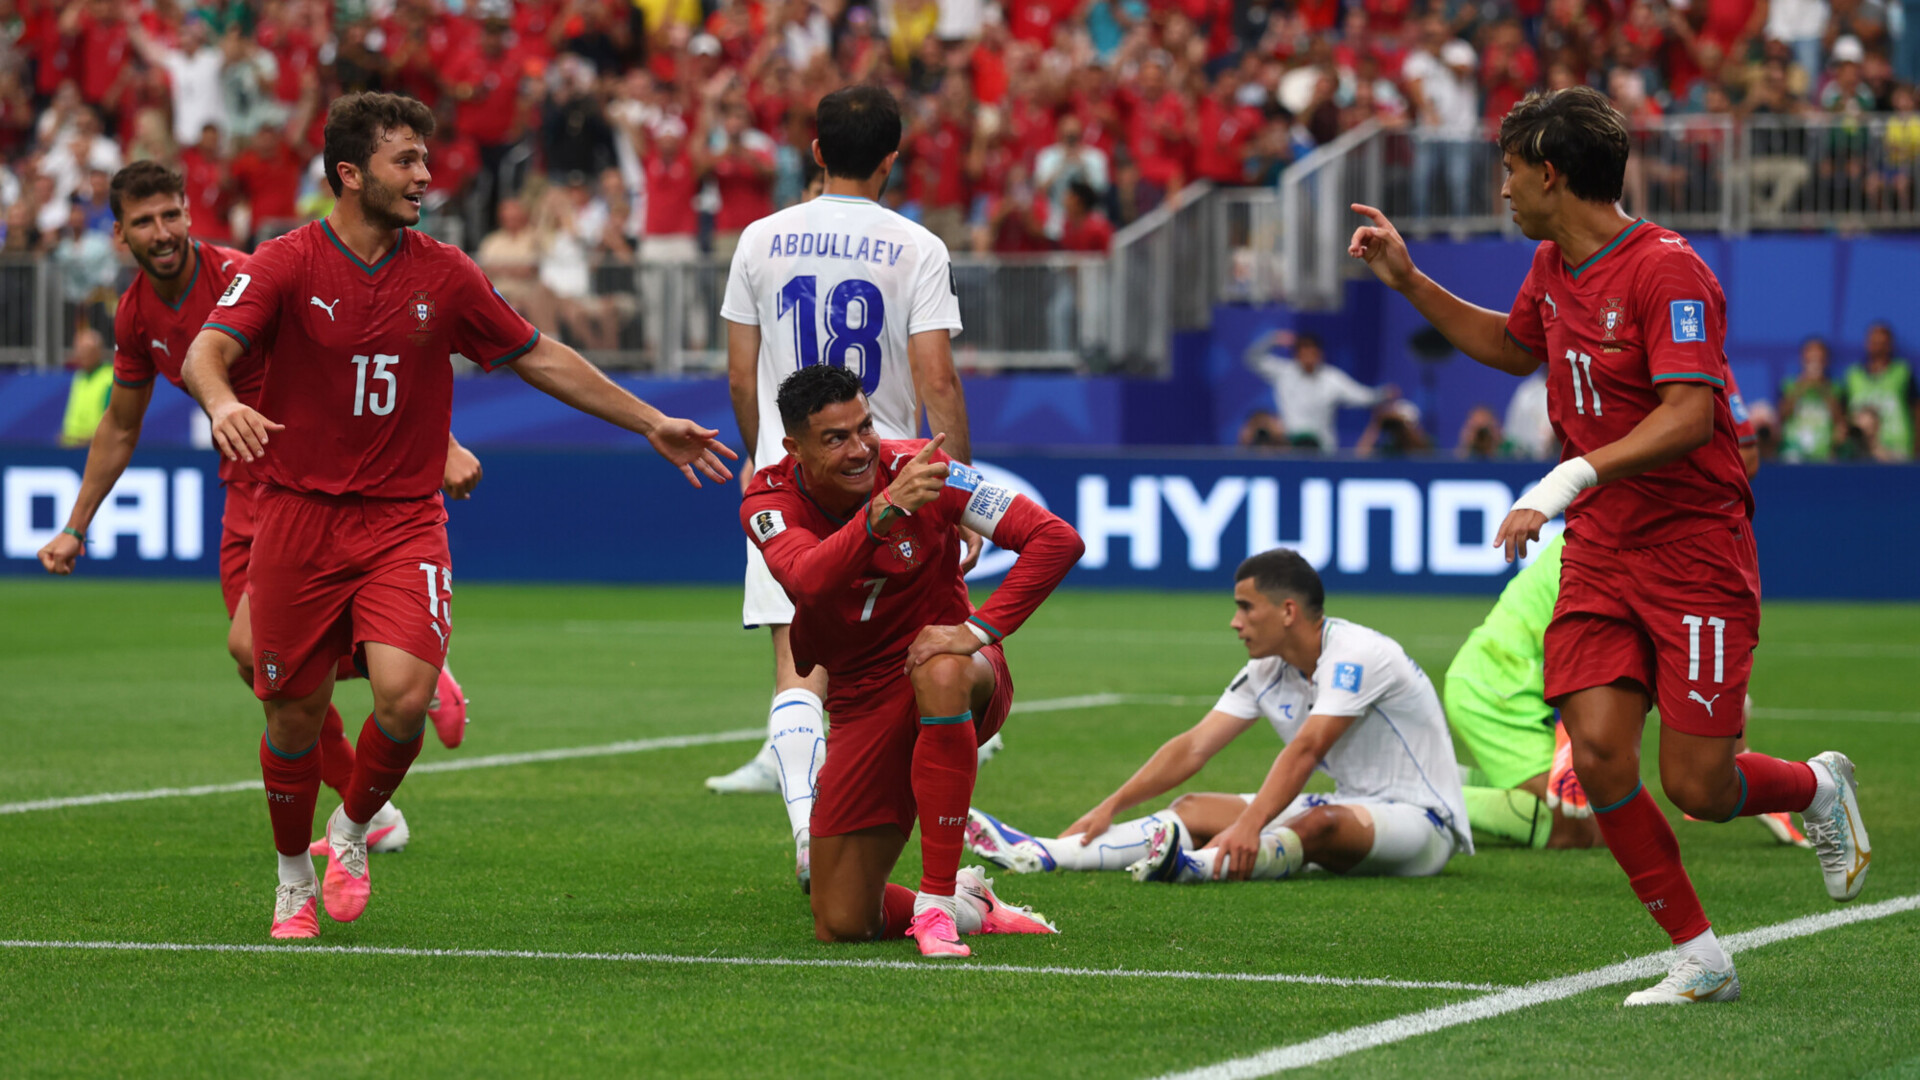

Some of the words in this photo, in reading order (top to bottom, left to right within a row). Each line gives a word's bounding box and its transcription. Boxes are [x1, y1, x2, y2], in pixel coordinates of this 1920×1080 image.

[768, 233, 904, 266] ABDULLAEV
[777, 275, 885, 397] 18
[351, 353, 399, 416] 15
[1565, 349, 1603, 416] 11
[3, 466, 203, 560] DAI
[860, 577, 888, 621] 7
[1682, 614, 1726, 683] 11
[773, 726, 813, 740] SEVEN
